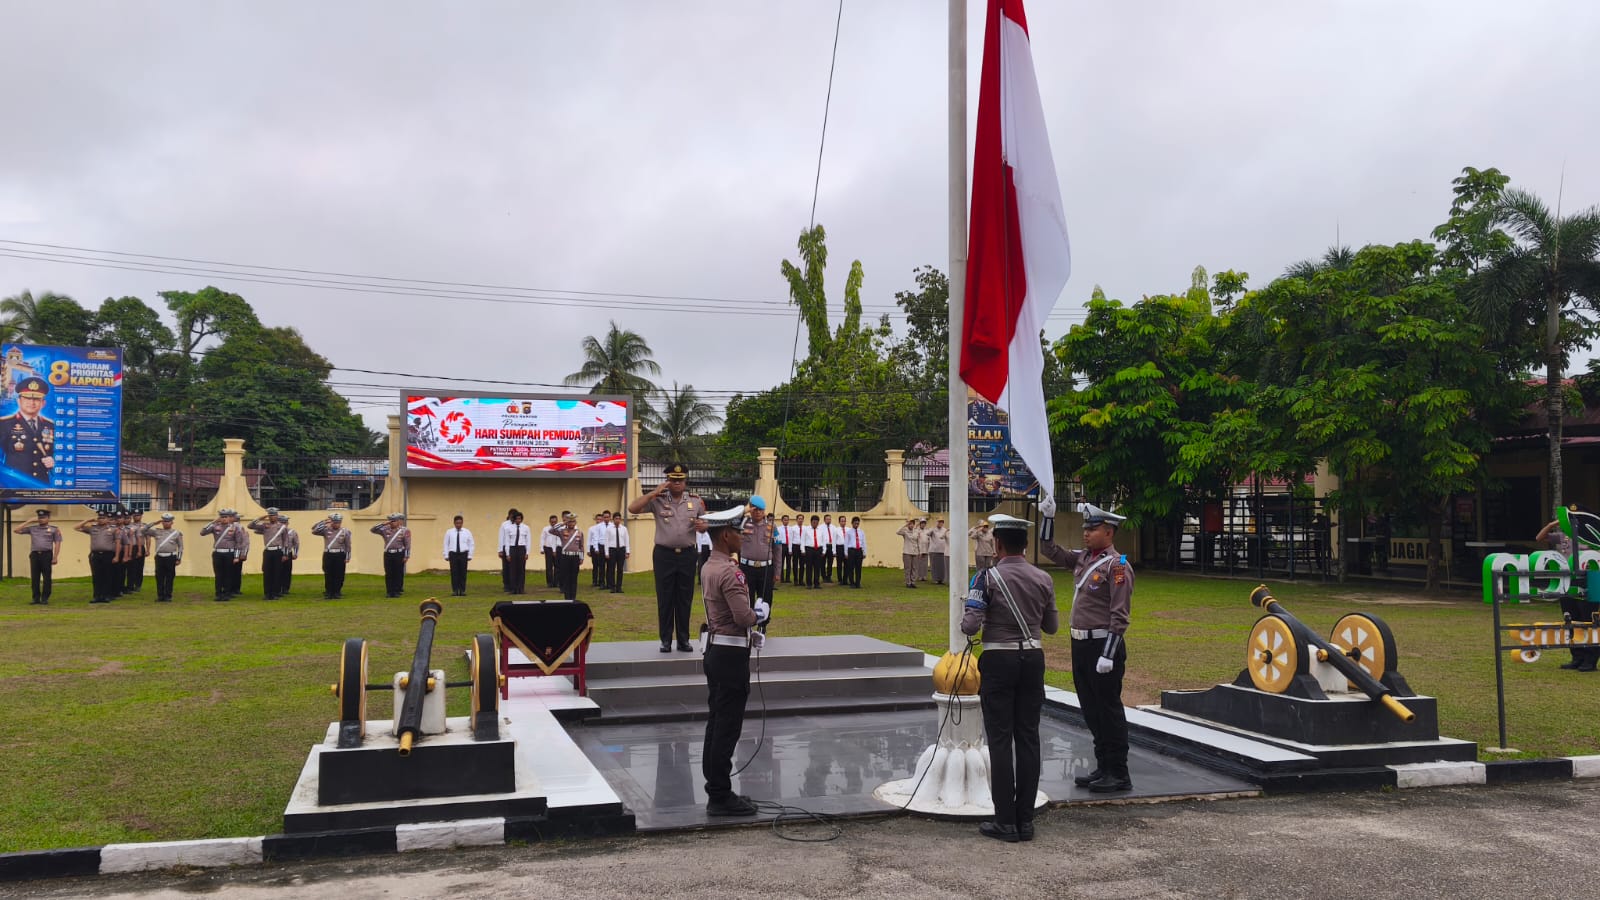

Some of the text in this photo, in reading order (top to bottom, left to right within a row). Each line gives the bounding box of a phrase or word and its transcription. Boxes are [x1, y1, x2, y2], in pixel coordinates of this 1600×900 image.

[70, 362, 110, 371] PROGRAM
[48, 360, 70, 386] 8
[70, 369, 114, 378] PRIORITAS
[70, 376, 115, 387] KAPOLRI
[502, 418, 537, 429] Peringatan
[475, 428, 581, 441] HARI SUMPAH PEMUDA
